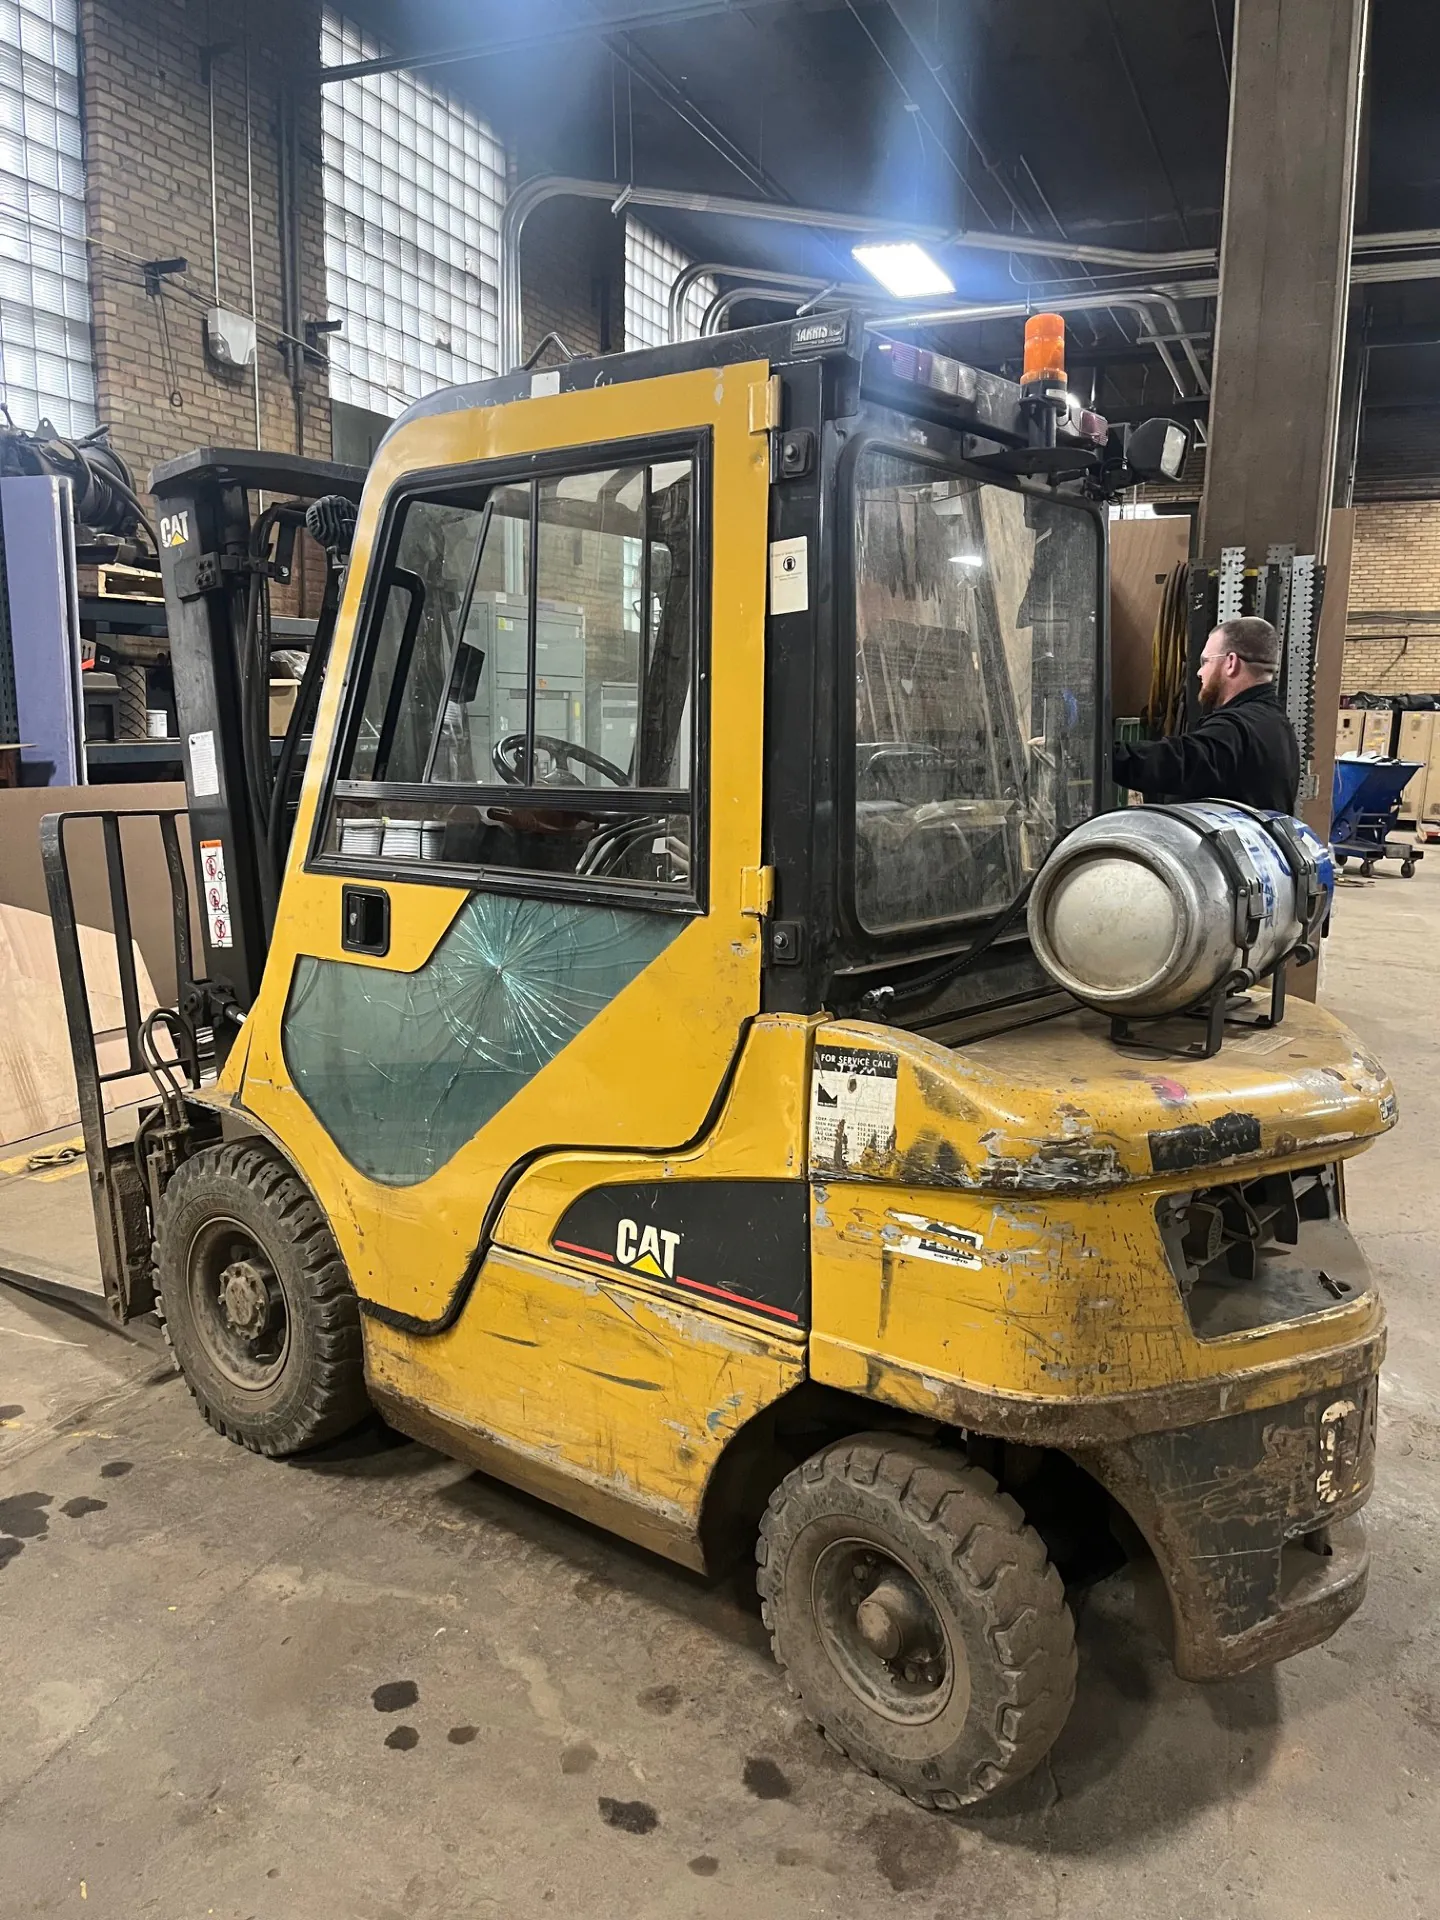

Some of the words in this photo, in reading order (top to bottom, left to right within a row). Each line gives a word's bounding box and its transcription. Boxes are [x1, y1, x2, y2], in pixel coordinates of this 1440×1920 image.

[160, 511, 189, 548] CAT
[821, 1053, 836, 1062] FOR
[839, 1056, 870, 1066] SERVICE
[873, 1059, 891, 1069] CALL
[616, 1218, 680, 1278] CAT
